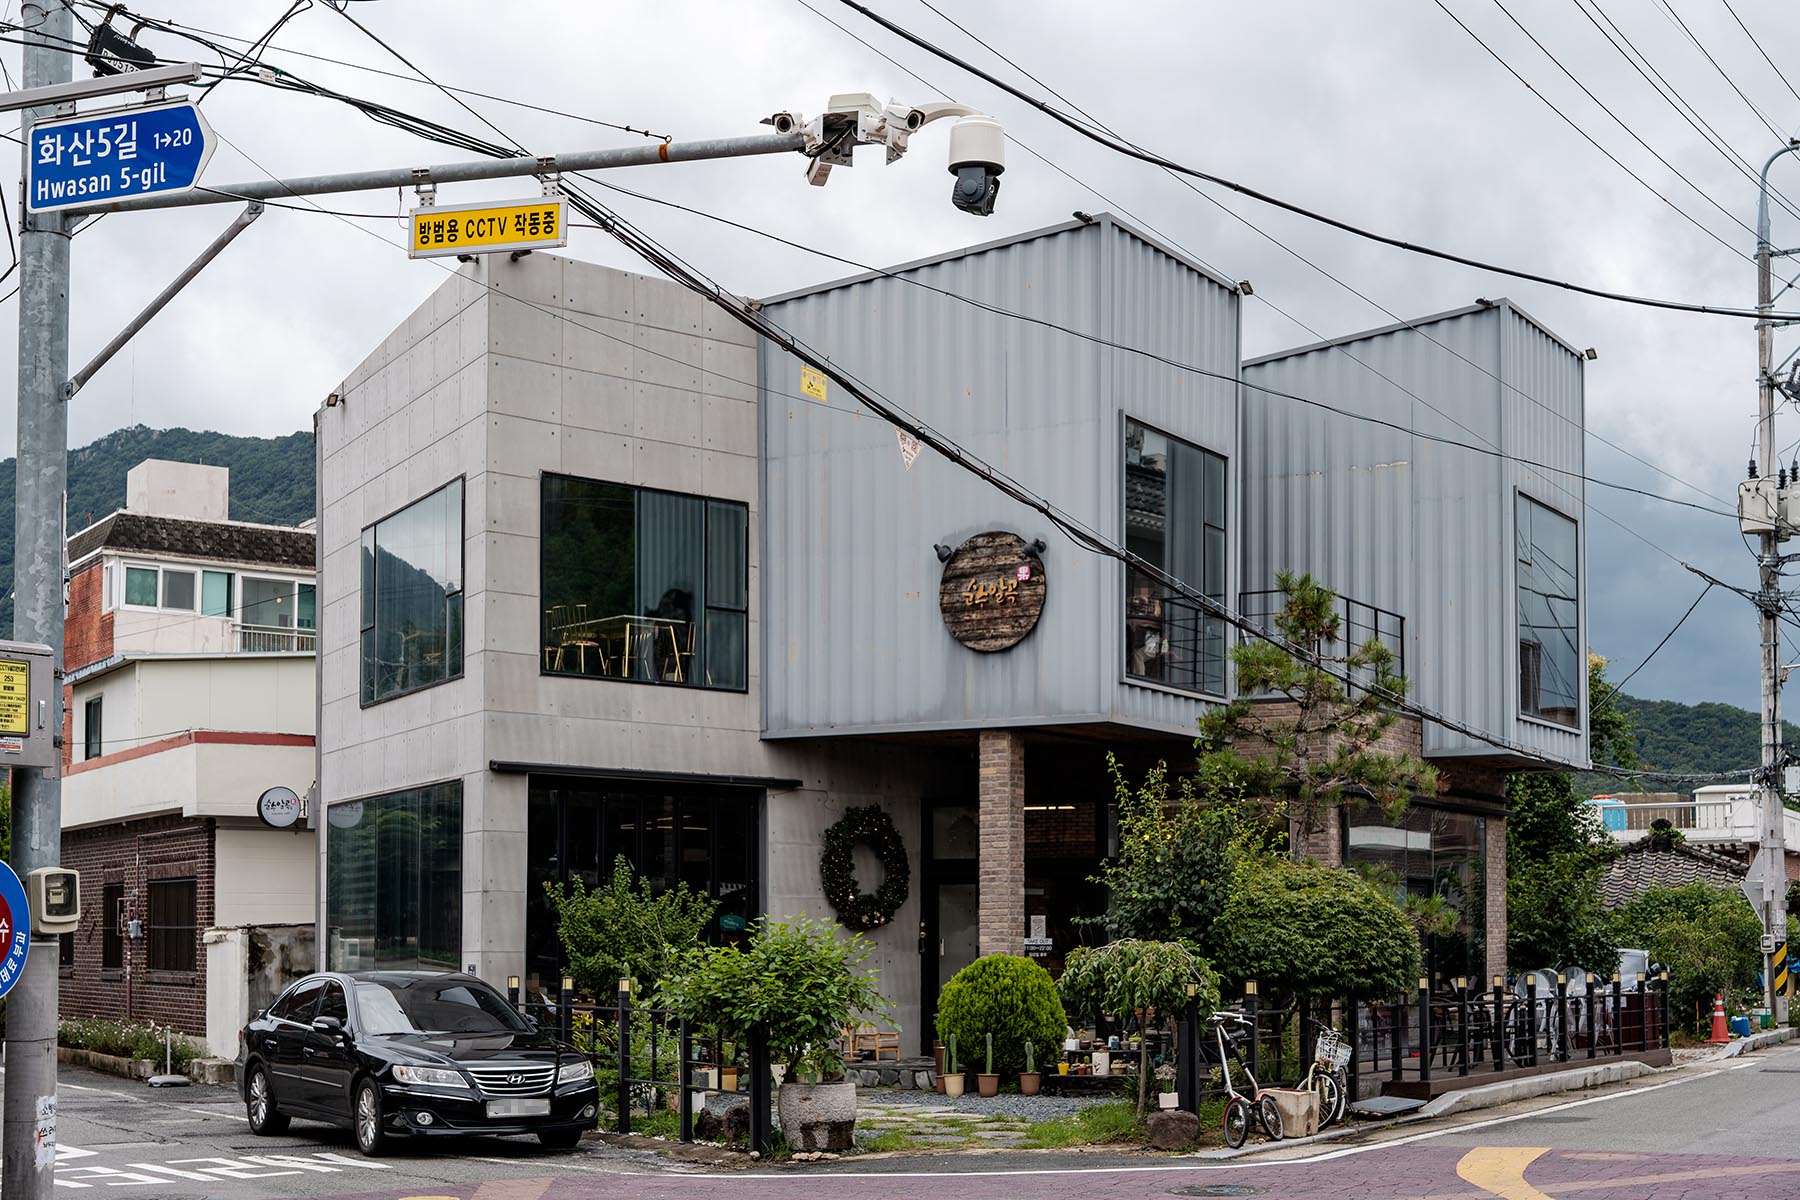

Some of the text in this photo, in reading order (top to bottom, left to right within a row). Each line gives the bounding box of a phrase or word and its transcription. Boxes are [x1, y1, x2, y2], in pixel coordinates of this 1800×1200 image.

[38, 121, 137, 167] 화산5길
[37, 161, 166, 201] Hwasan 5-gil
[419, 211, 555, 245] 방범용 CCTV 작동중
